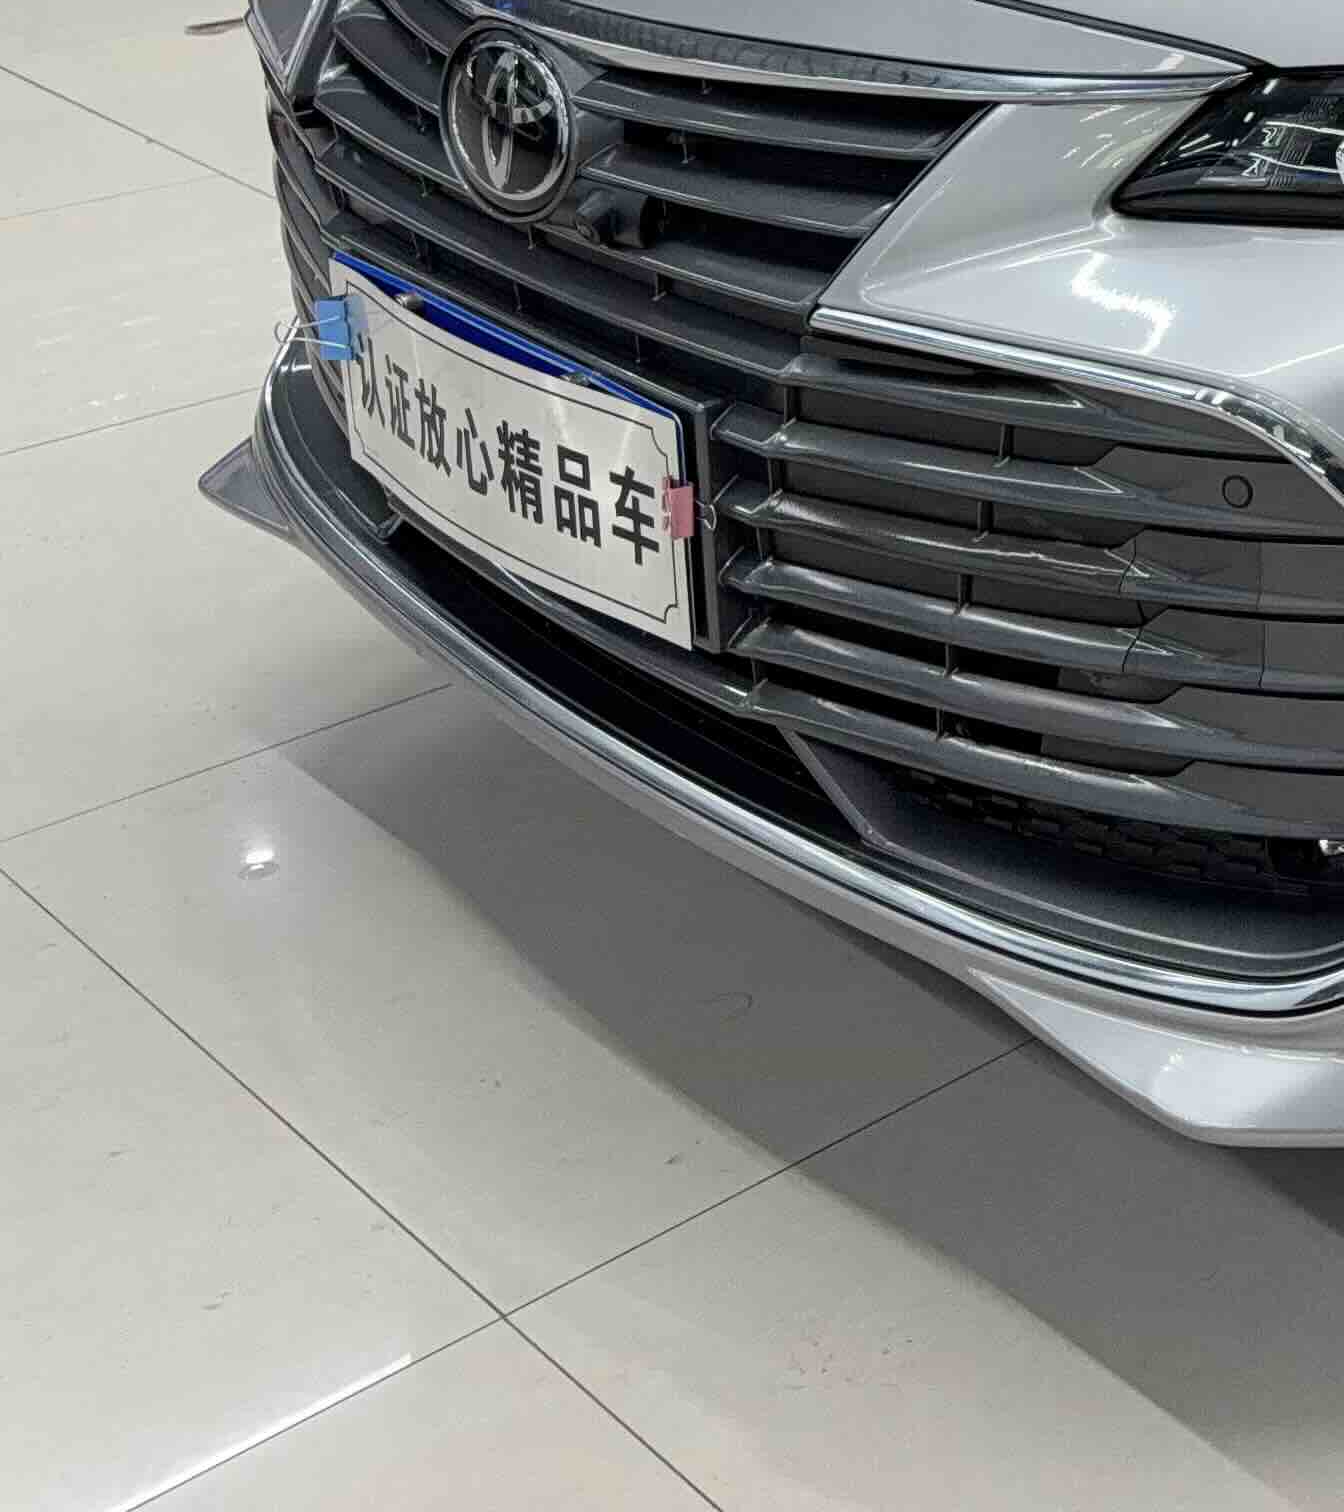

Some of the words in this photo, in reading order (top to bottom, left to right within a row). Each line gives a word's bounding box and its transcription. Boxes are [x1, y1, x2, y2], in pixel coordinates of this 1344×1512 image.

[354, 332, 660, 566] 认证放心精品车
